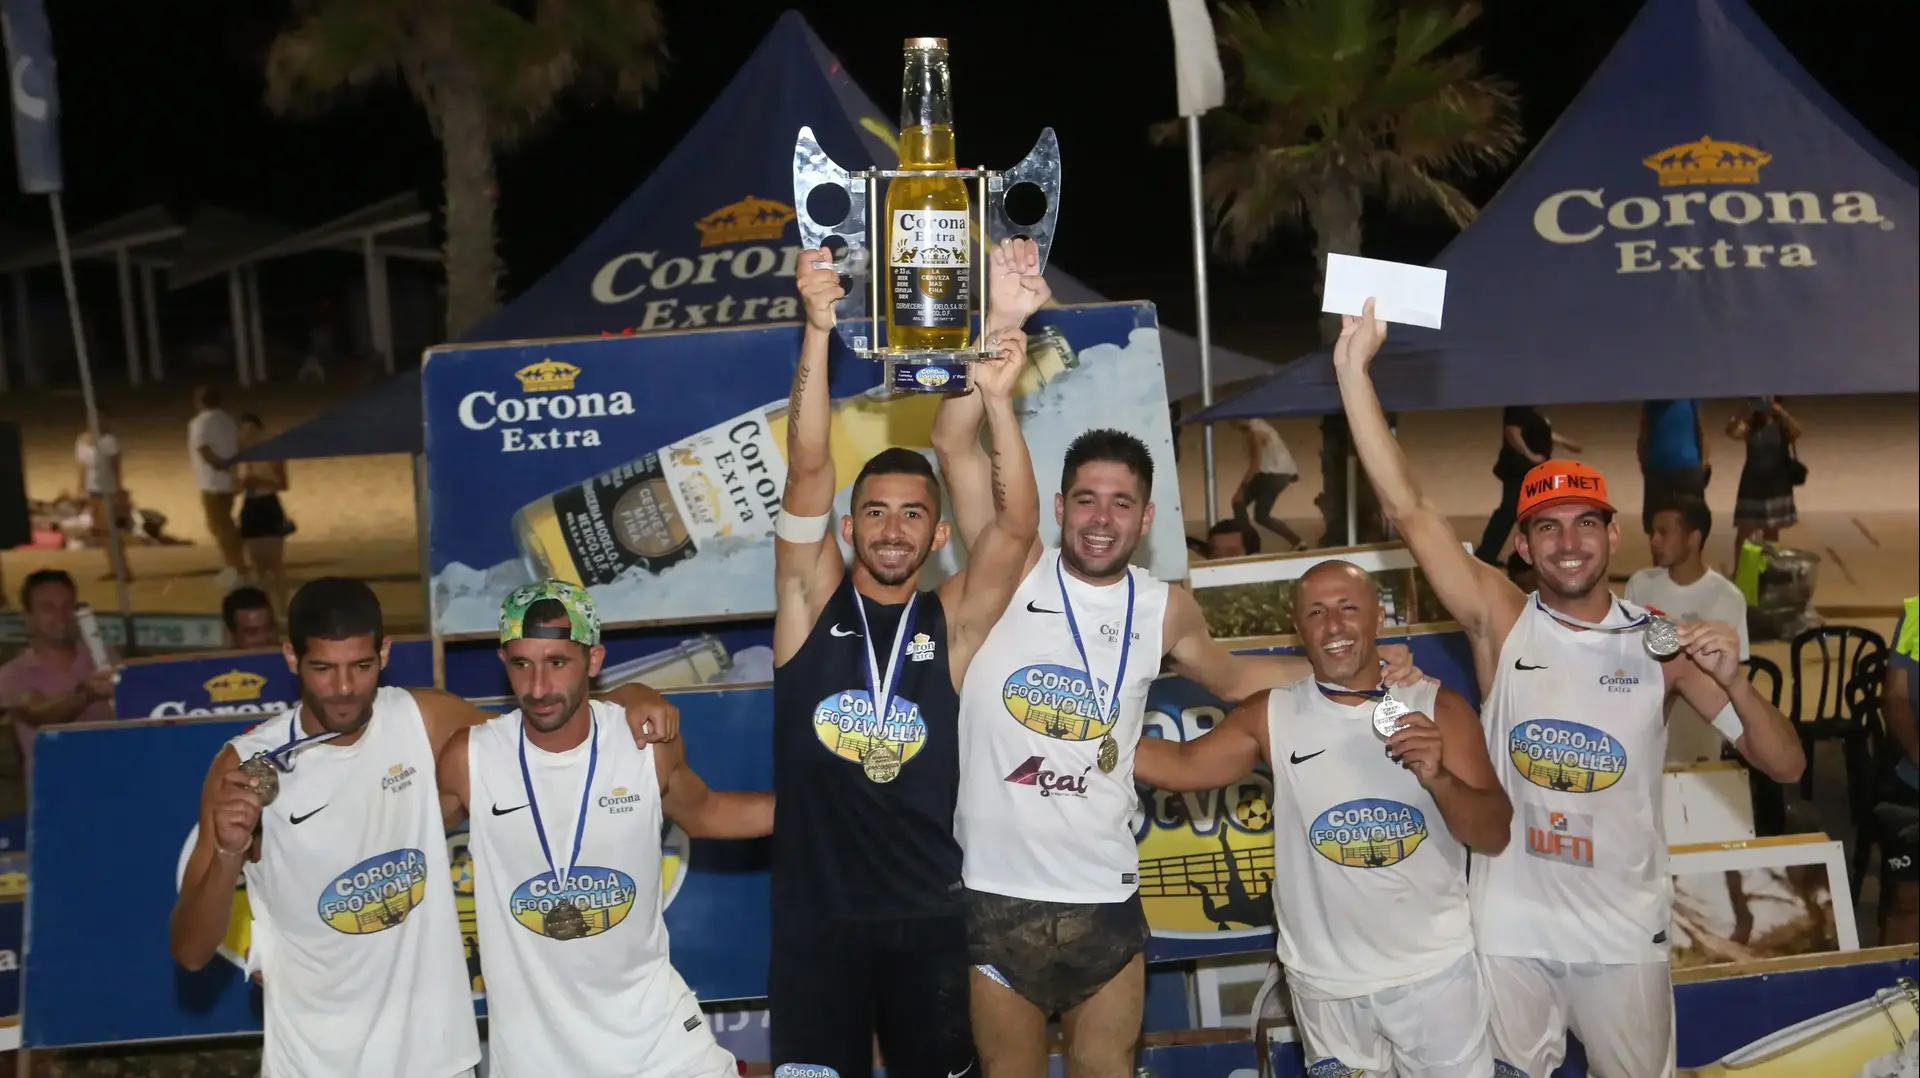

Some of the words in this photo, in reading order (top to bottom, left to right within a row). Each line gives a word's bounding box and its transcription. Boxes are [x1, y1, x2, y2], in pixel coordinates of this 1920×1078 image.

[900, 213, 966, 231] Corona
[1534, 188, 1884, 244] Corona
[915, 231, 956, 242] Etra
[1614, 239, 1816, 274] Extra
[638, 295, 798, 331] Extra
[458, 391, 636, 431] Corona
[501, 427, 602, 452] Extra
[715, 450, 754, 523] Extra
[728, 420, 782, 527] Coron
[1526, 474, 1600, 499] WINFNET
[621, 510, 642, 543] FINA
[633, 507, 654, 538] MAS
[640, 488, 671, 547] CERVEZA
[1599, 674, 1640, 685] Corona
[382, 766, 416, 790] Corona
[598, 793, 641, 808] Corona
[609, 806, 634, 814] Extra
